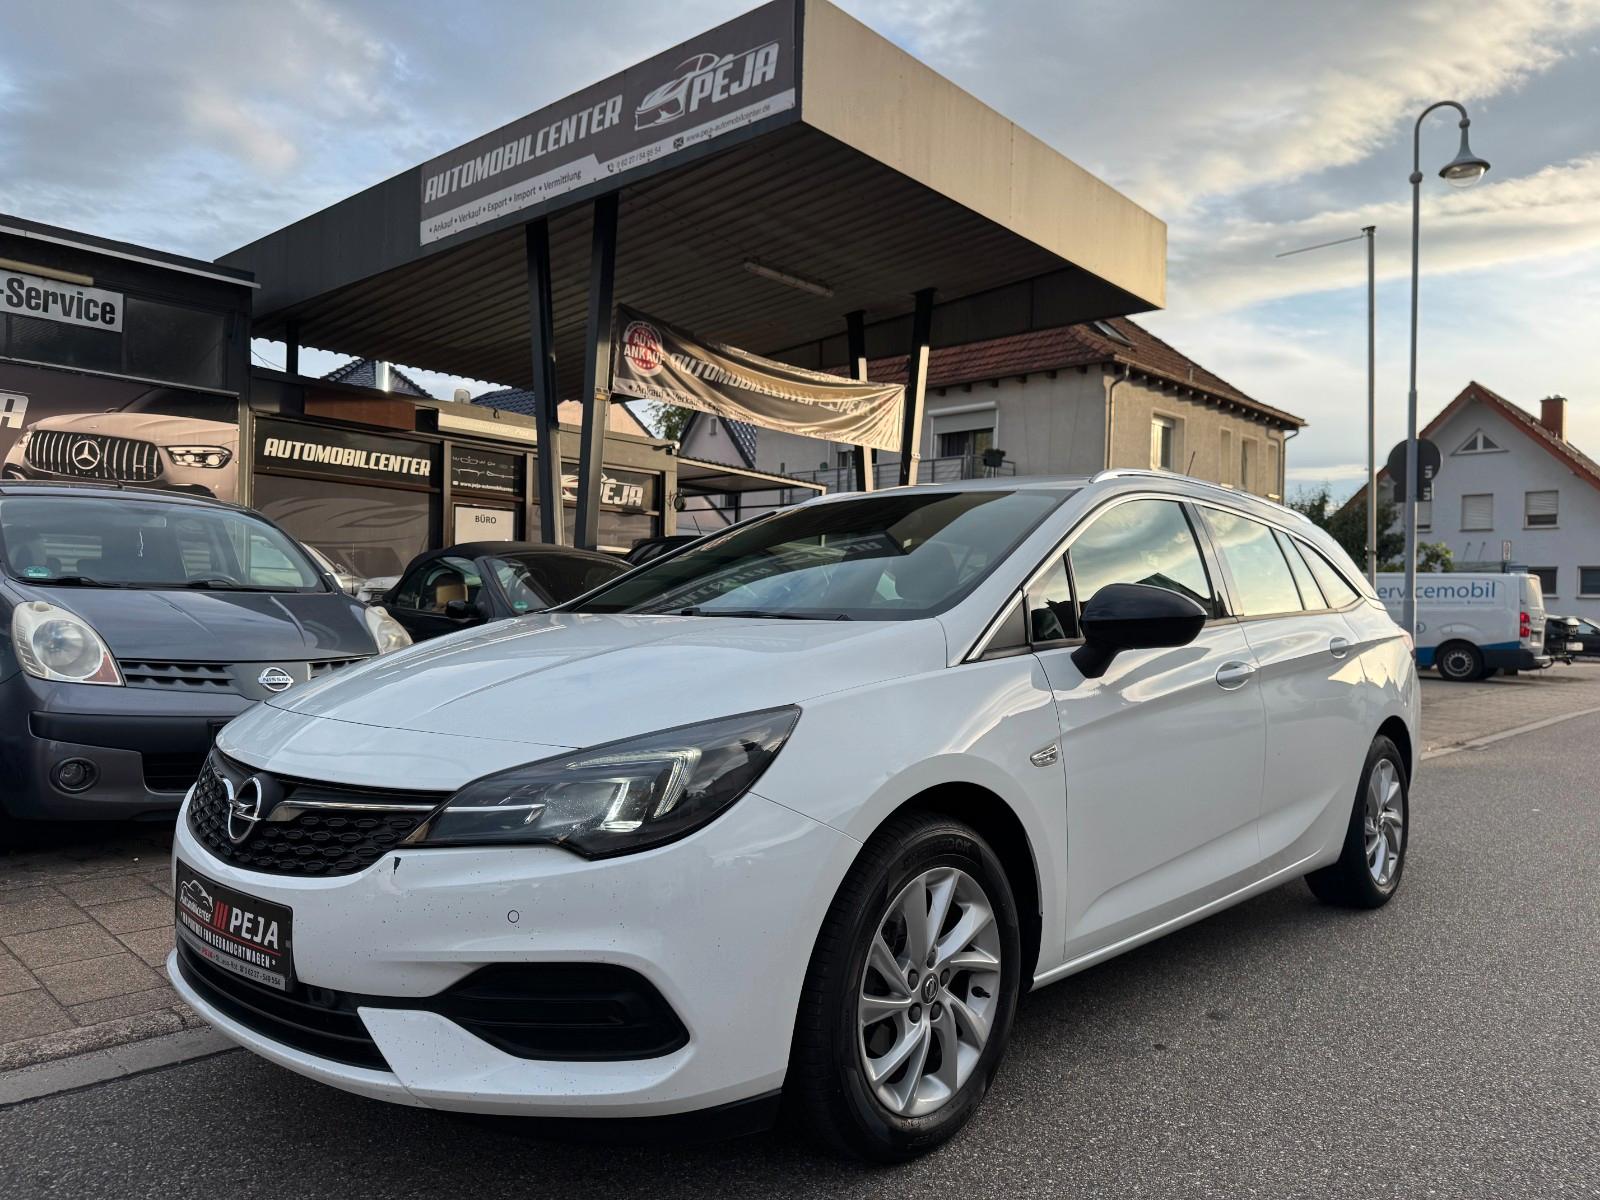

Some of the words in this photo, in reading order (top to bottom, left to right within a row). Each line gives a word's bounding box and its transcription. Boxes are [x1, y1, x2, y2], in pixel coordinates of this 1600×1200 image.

[424, 94, 623, 204] AUTOMOBILCENTER
[689, 42, 779, 112] PEJA
[432, 216, 454, 234] Ankauf
[458, 205, 481, 226] Verkauf
[487, 195, 508, 214] Export
[513, 186, 536, 204] Import
[543, 168, 582, 192] Vermittlung
[624, 344, 666, 364] ANKAUF
[263, 438, 431, 477] AUTOMOBILCENTER
[600, 482, 643, 507] EJA
[474, 513, 497, 524] BÜRO
[229, 906, 279, 950] PEJA
